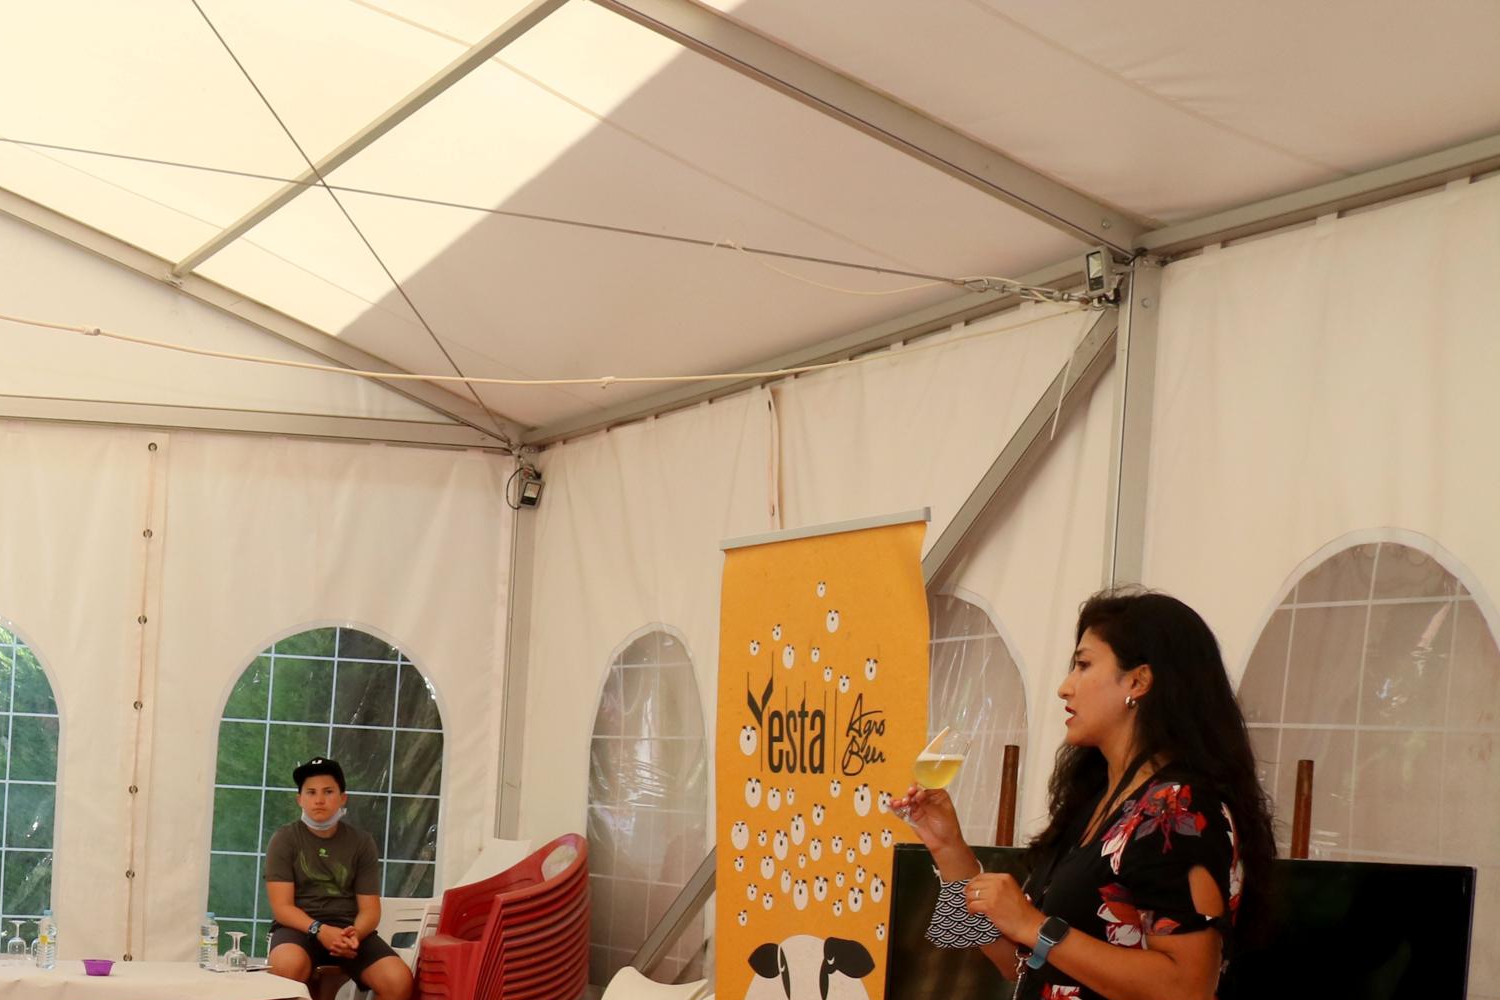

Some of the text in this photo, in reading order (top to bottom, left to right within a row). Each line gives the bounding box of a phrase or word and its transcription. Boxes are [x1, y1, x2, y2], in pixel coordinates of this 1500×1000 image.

[746, 651, 827, 774] Yesta
[846, 692, 886, 751] Agro
[841, 735, 886, 777] Beer
